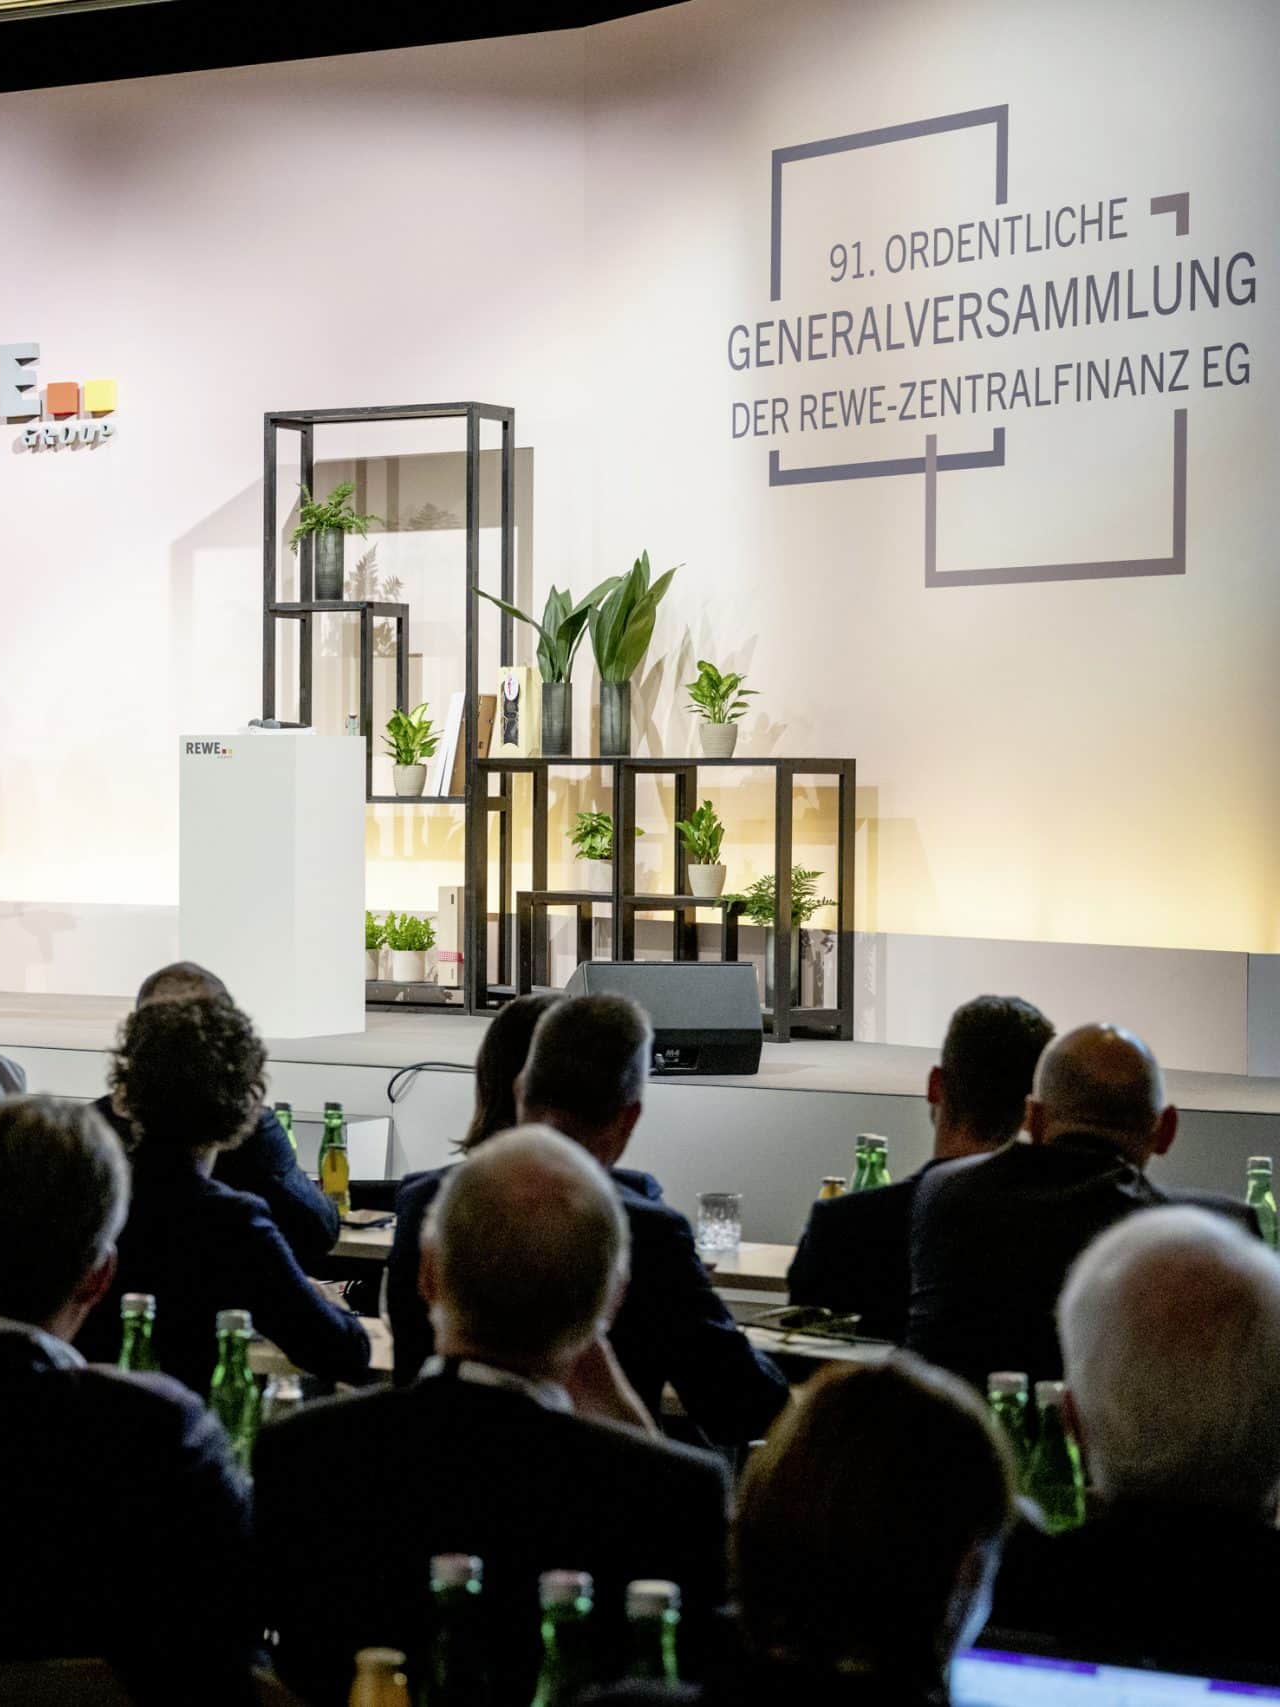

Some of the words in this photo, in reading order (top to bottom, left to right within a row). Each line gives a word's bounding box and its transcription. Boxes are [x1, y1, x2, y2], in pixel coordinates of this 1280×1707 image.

[829, 240, 875, 283] 91.
[884, 196, 1129, 274] ORDENTLICHE
[727, 251, 1257, 371] GENERALVERSAMMLUNG
[732, 397, 790, 439] DER
[799, 349, 1190, 432] REWE-ZENTRALFINANZ
[1202, 342, 1251, 389] EG
[20, 421, 115, 450] GROUP
[185, 742, 221, 755] REWE
